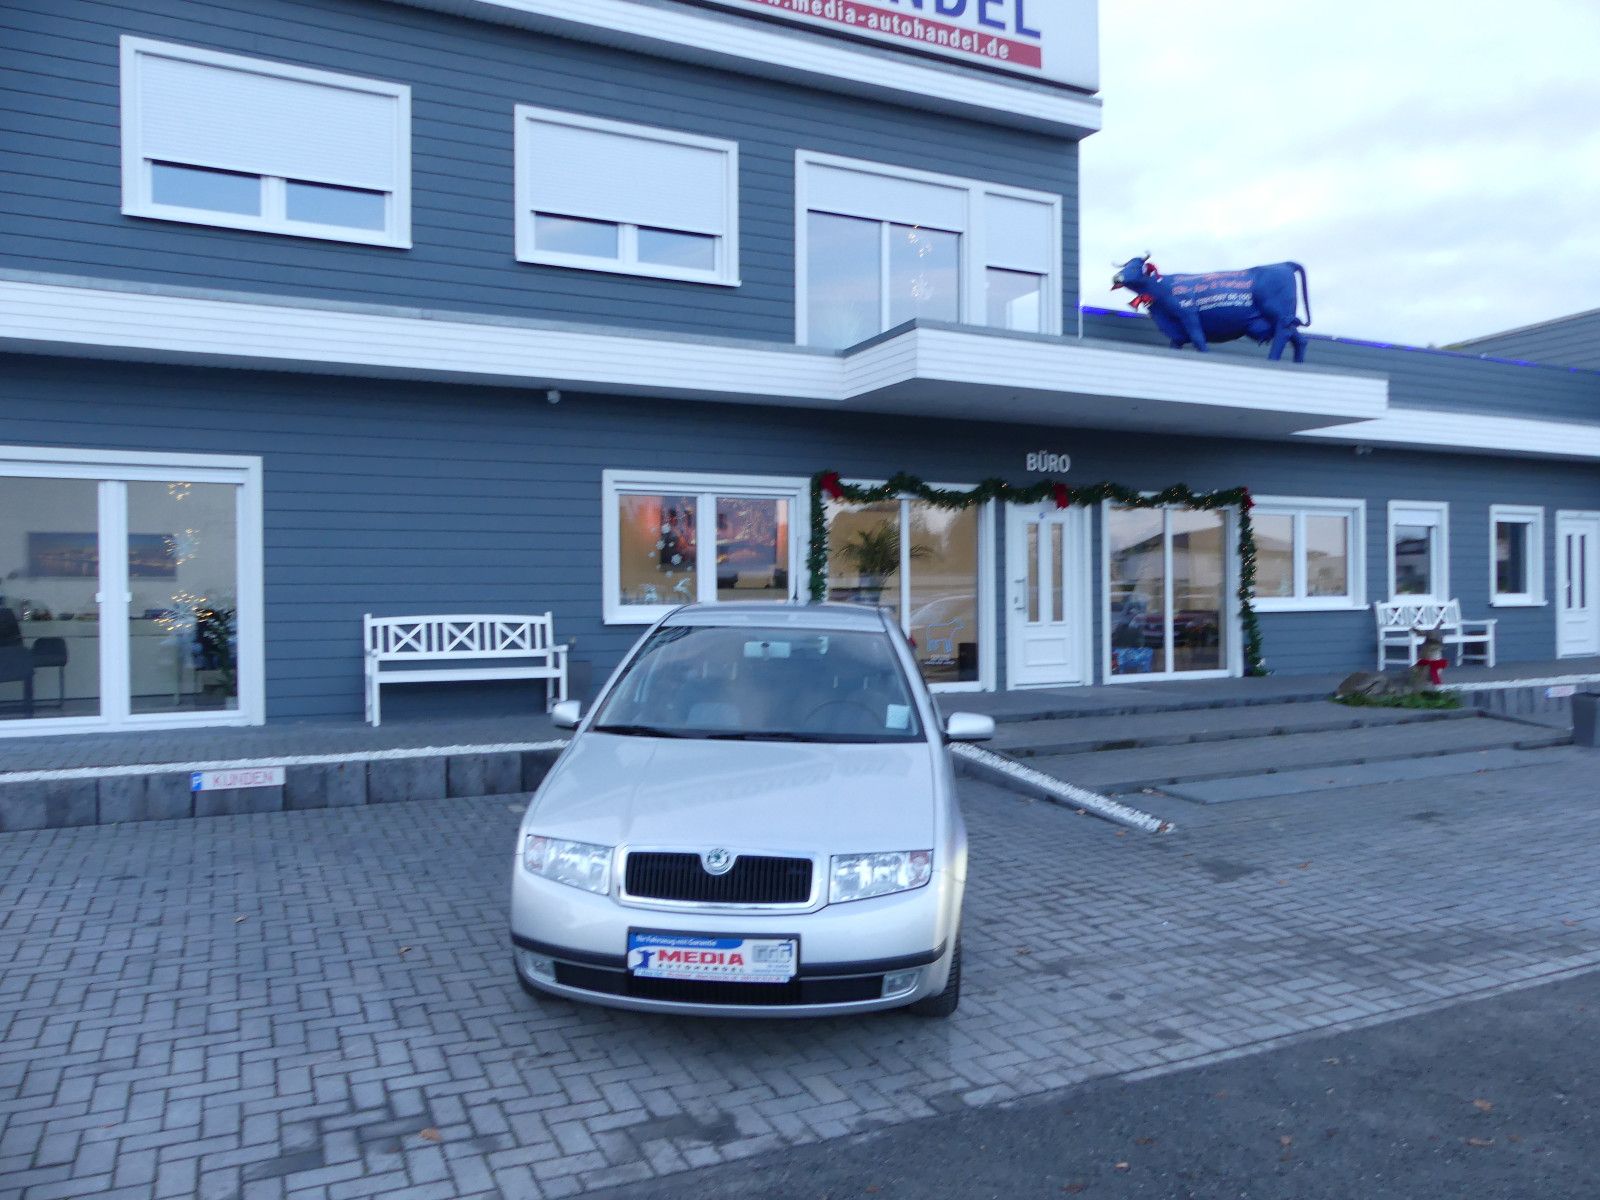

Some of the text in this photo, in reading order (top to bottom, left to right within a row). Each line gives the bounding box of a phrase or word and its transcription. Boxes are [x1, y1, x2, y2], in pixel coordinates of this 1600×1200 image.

[753, 0, 1009, 60] .media-autohandel.de
[1026, 450, 1071, 473] BÜRO
[658, 949, 744, 966] MEDIA
